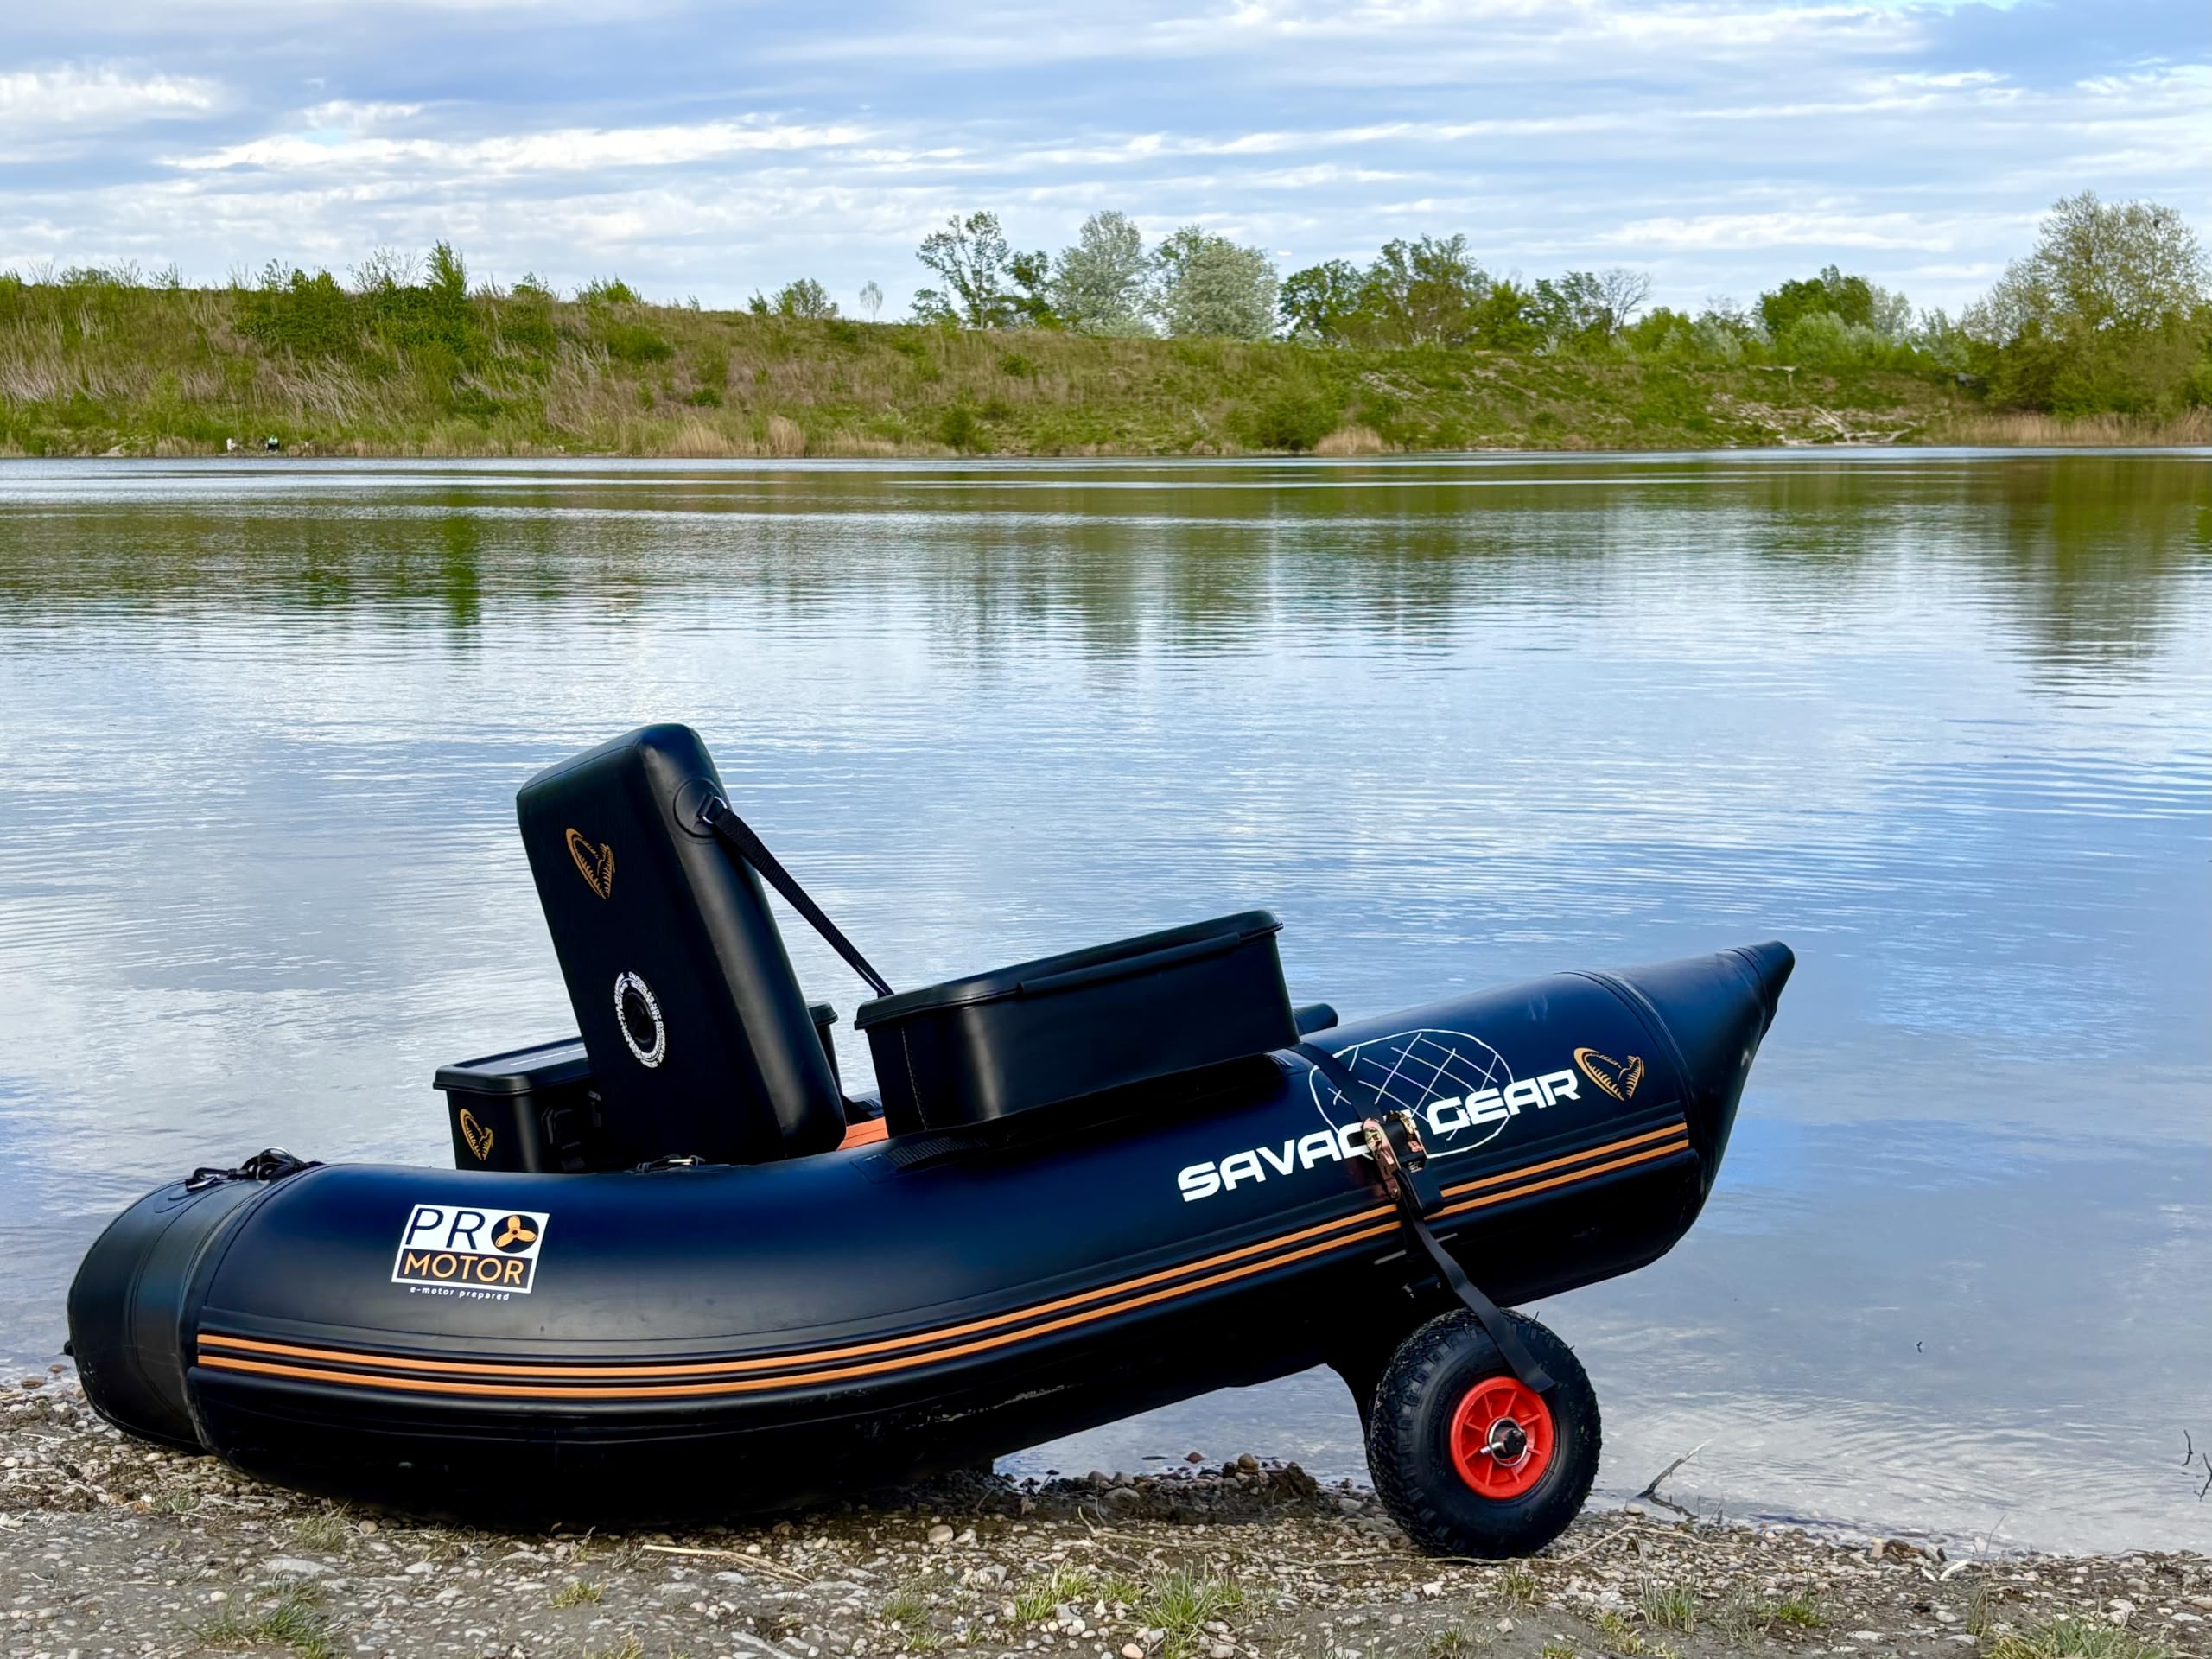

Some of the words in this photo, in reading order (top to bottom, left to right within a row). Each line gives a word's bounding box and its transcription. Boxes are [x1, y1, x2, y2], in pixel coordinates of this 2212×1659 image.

[1178, 1109, 1419, 1202] SAVAG
[1427, 1068, 1581, 1135] GEAR
[404, 1251, 524, 1285] MOTOR
[410, 1285, 454, 1296] e-motor
[459, 1289, 510, 1301] prepared
